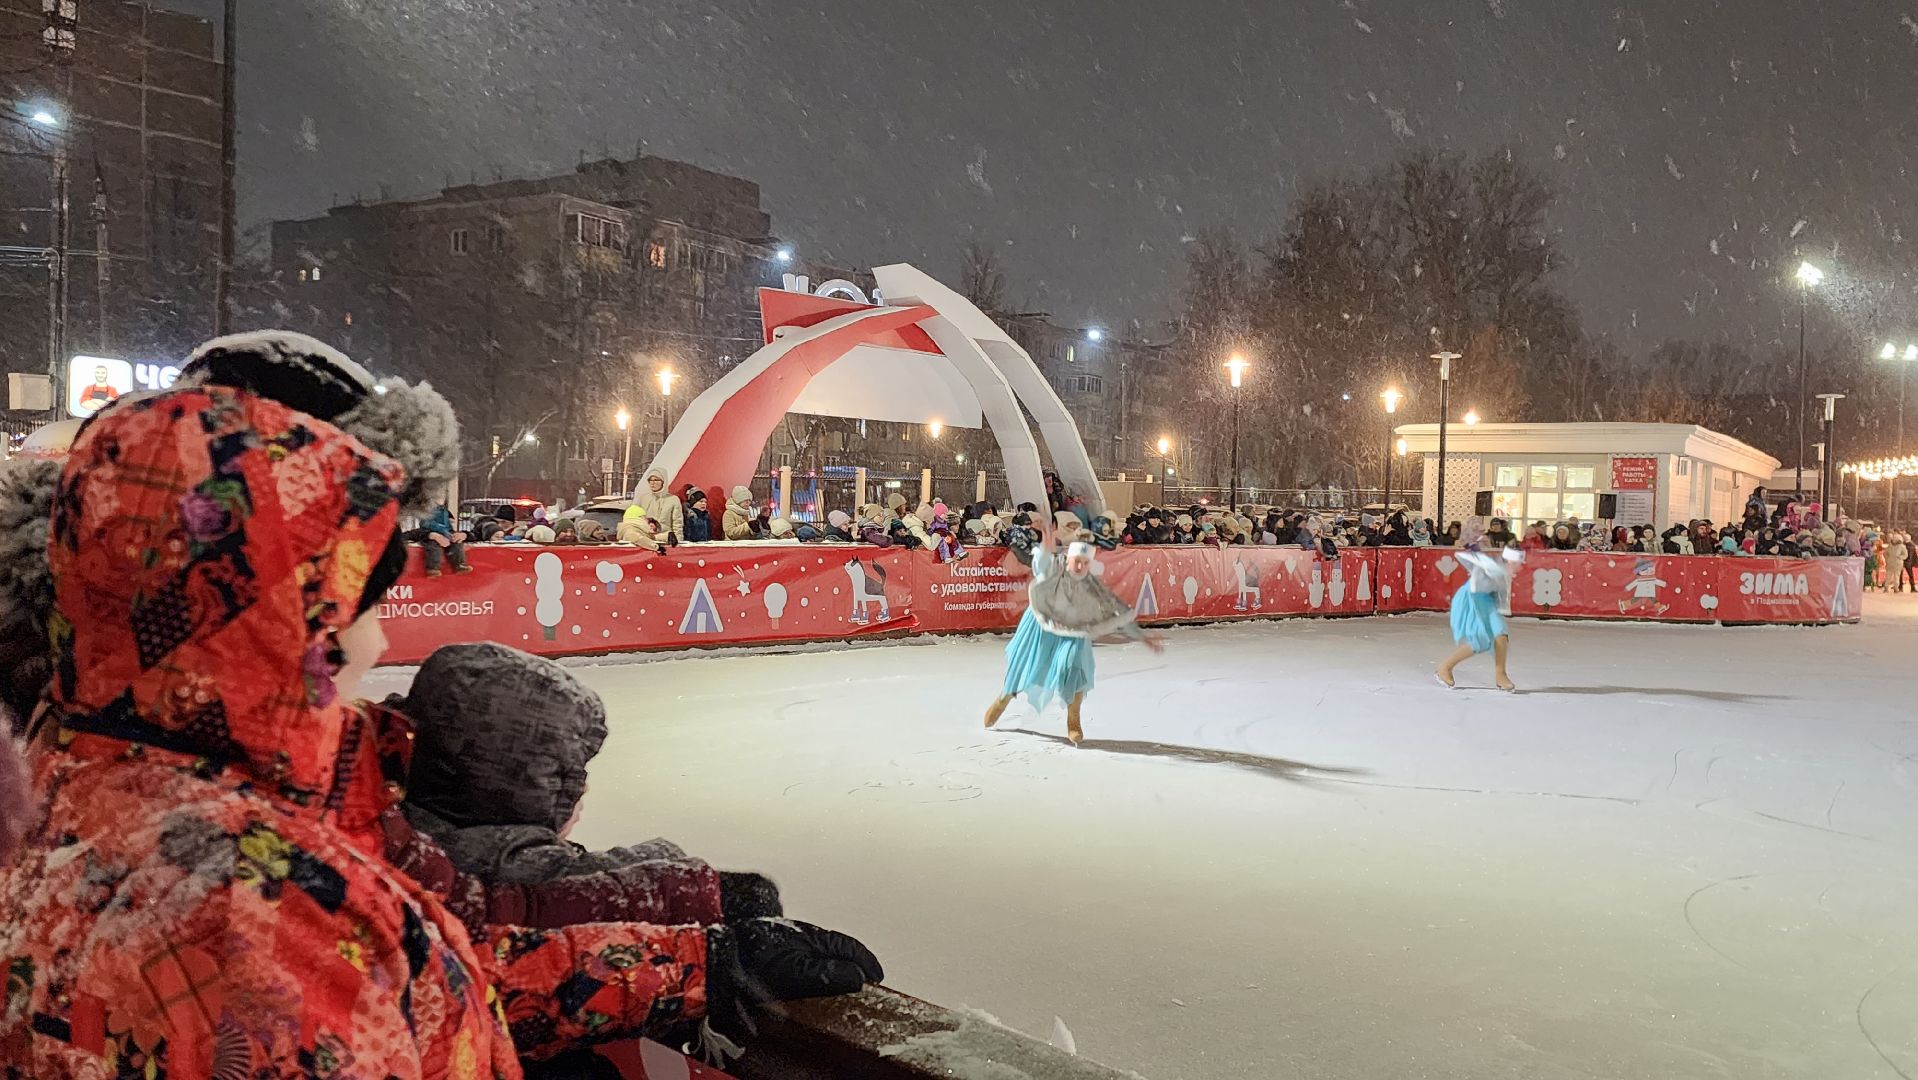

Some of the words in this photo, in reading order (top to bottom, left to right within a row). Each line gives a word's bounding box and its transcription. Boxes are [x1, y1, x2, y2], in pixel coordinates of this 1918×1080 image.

[950, 563, 1009, 577] Катайтесь
[930, 583, 938, 594] с
[941, 582, 1027, 597] удовольствием
[1739, 572, 1809, 595] ЗИМА
[376, 601, 494, 619] ДМОСКОВЬЯ
[944, 602, 974, 611] Команда
